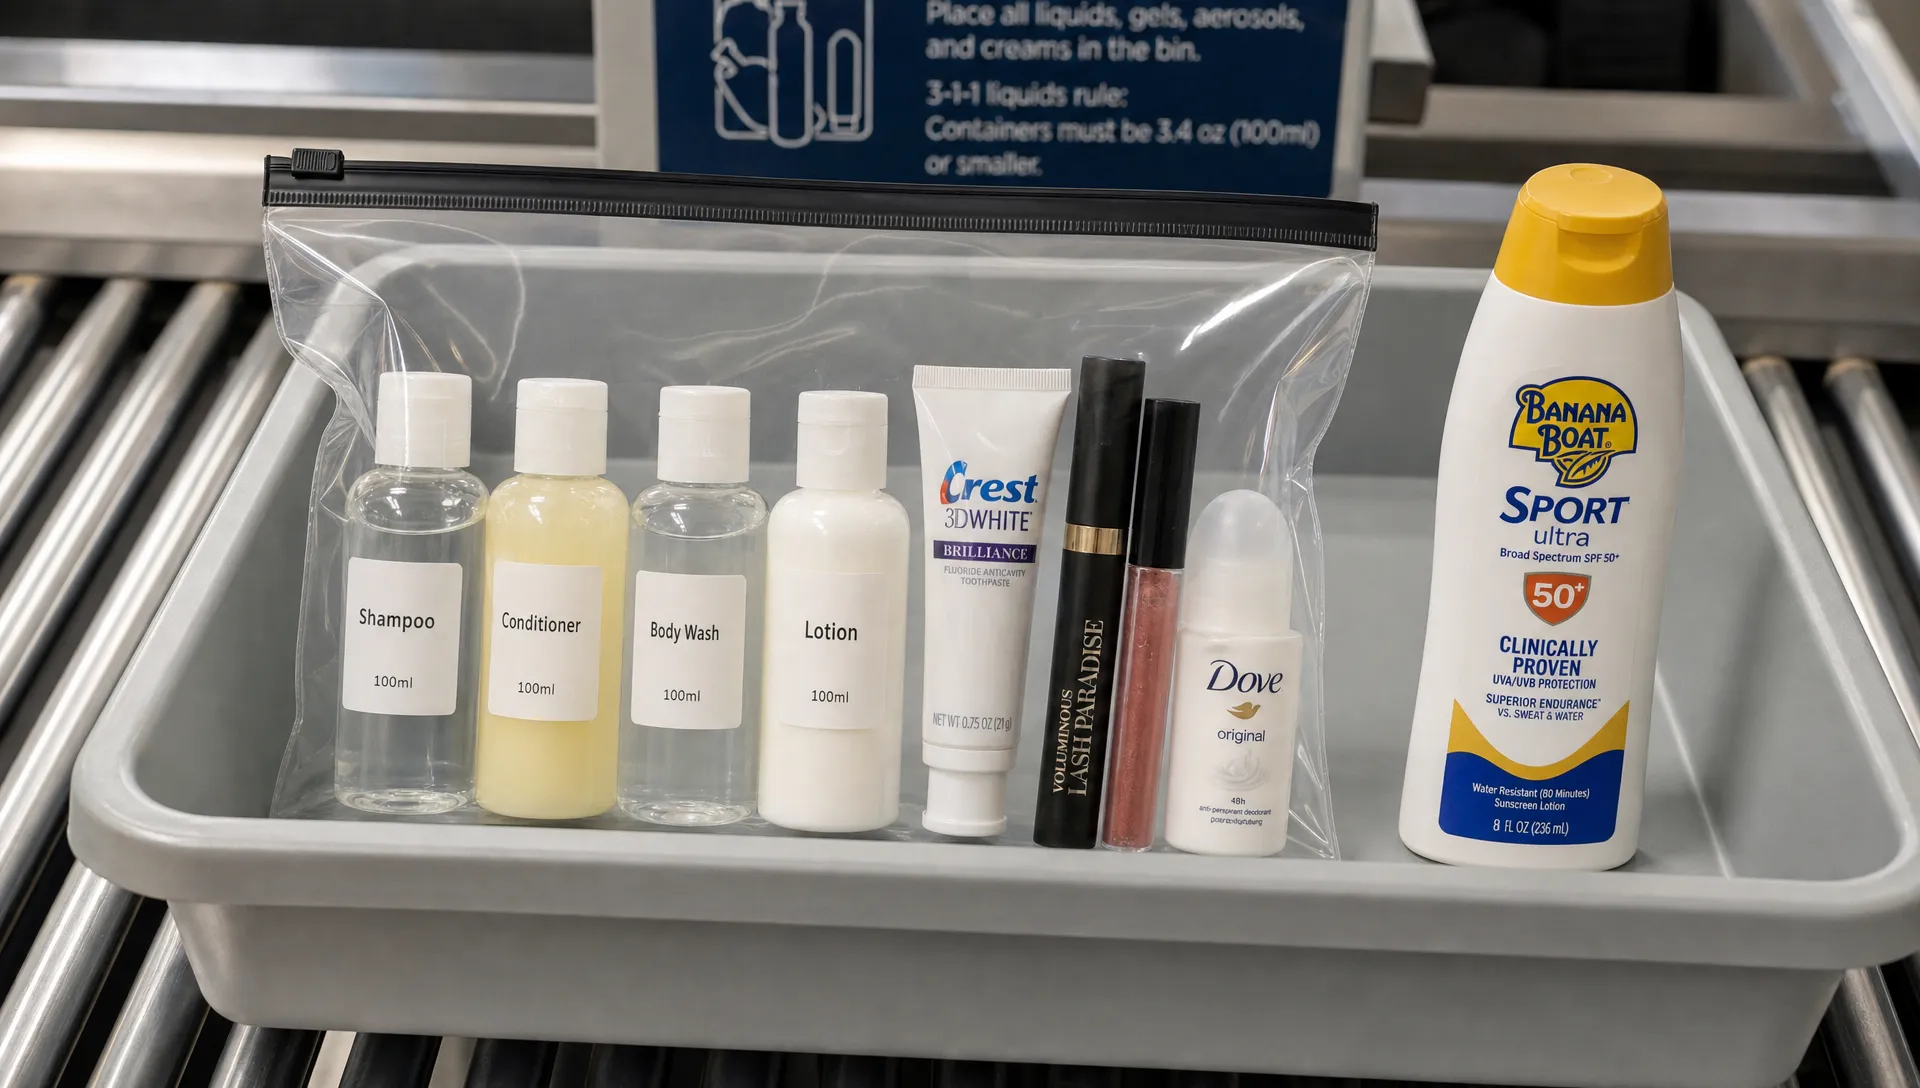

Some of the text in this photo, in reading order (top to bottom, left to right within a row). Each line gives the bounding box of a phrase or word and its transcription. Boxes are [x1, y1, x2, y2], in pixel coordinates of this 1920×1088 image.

[926, 0, 1305, 33] Place all liquids, gels, aerosols,
[925, 33, 1201, 62] and creams in the bin.
[926, 79, 1129, 111] 3-1-1 liquids rule:
[925, 114, 1321, 149] Containers must be 3.4 oz (100ml)
[924, 150, 1043, 177] or smaller.
[1522, 390, 1627, 423] BANANA
[940, 460, 1038, 505] Crest
[1499, 485, 1630, 524] SPORT
[1534, 526, 1590, 547] ultra
[943, 544, 1028, 560] BRILLIANCE
[1500, 547, 1620, 563] Broad Spectrum SPF 50+
[944, 566, 1026, 577] FLUORIDE ANTICAVITY
[960, 577, 1010, 587] TOOTHPASTE
[1532, 582, 1584, 609] 50+
[359, 608, 435, 632] Shampoo
[501, 612, 581, 633] Conditioner
[650, 621, 719, 644] Body Wash
[805, 621, 858, 641] Lotion
[1500, 635, 1598, 657] CLINICALLY
[1513, 657, 1581, 676] PROVEN
[374, 675, 413, 689] 100ml
[1206, 659, 1283, 694] Dove
[1493, 674, 1596, 690] UVA/UVB PROTECTION
[518, 682, 555, 695] 100ml
[664, 689, 700, 702] 100ml
[811, 690, 848, 703] 100ml
[1067, 619, 1104, 796] LASH PARADISE
[1486, 693, 1537, 708] SUPERIOR
[933, 712, 946, 726] NET
[947, 714, 960, 728] WT
[962, 716, 980, 729] 0.75
[981, 717, 993, 730] OZ
[1497, 708, 1584, 721] VS. SWEAT & WATER
[1053, 689, 1073, 793] VOLUMINOUS
[1217, 729, 1265, 744] original
[1472, 782, 1498, 795] Water
[1499, 786, 1538, 798] Resistant
[1555, 788, 1590, 799] Minutes)
[1231, 797, 1246, 805] 48h
[1494, 798, 1565, 810] Sunscreen Lotion
[1493, 818, 1500, 831] 8
[1504, 820, 1513, 833] FL
[1516, 821, 1529, 834] OZ
[1531, 821, 1551, 836] (236
